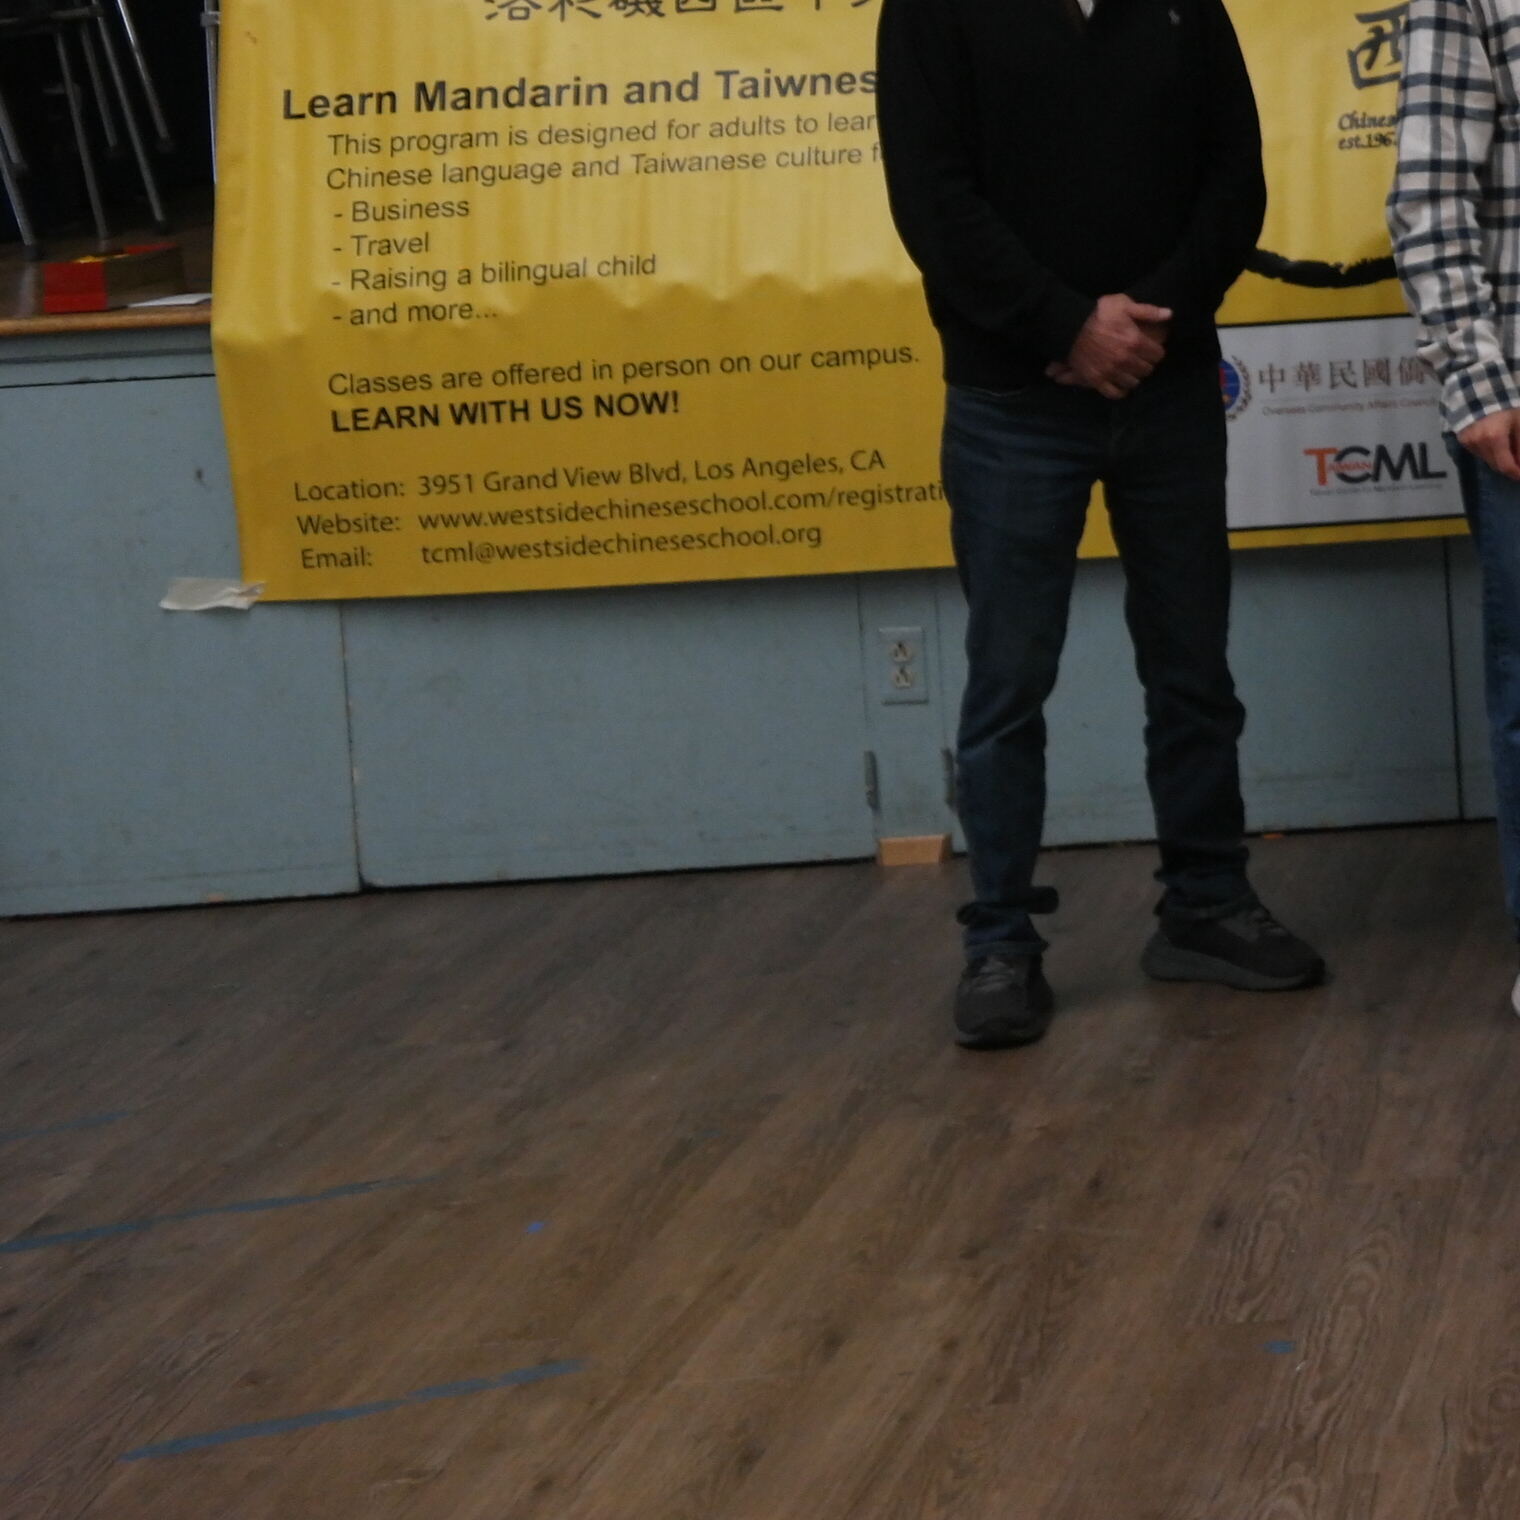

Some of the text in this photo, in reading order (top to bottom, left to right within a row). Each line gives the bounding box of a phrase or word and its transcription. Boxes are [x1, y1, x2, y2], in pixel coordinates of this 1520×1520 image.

[282, 67, 878, 120] Learn Mandarin and Taiwnes
[327, 111, 877, 158] This program is designed for adults to lear
[1338, 110, 1398, 130] Chines
[326, 166, 433, 190] Chinese
[441, 161, 563, 187] language
[571, 155, 620, 178] and
[630, 150, 767, 175] Taiwanese
[775, 145, 863, 168] culture
[351, 198, 471, 223] Business
[350, 232, 430, 257] Travel
[350, 268, 448, 292] Raising
[456, 267, 472, 286] a
[481, 256, 588, 287] bilingual
[596, 253, 656, 278] child
[349, 302, 398, 326] and
[407, 302, 498, 323] more...
[328, 345, 919, 396] Classes are offered in person on our campus.
[330, 389, 680, 433] LEARN WITH US NOW!
[294, 448, 886, 502] Location: 3951 Grand View Blvd, Los Angeles, CA
[1303, 442, 1448, 486] TCML
[297, 479, 944, 536] Website: www.westsidechineseschool.com/registrati
[301, 523, 822, 570] Email: tcml@westsidechineseschool.org
